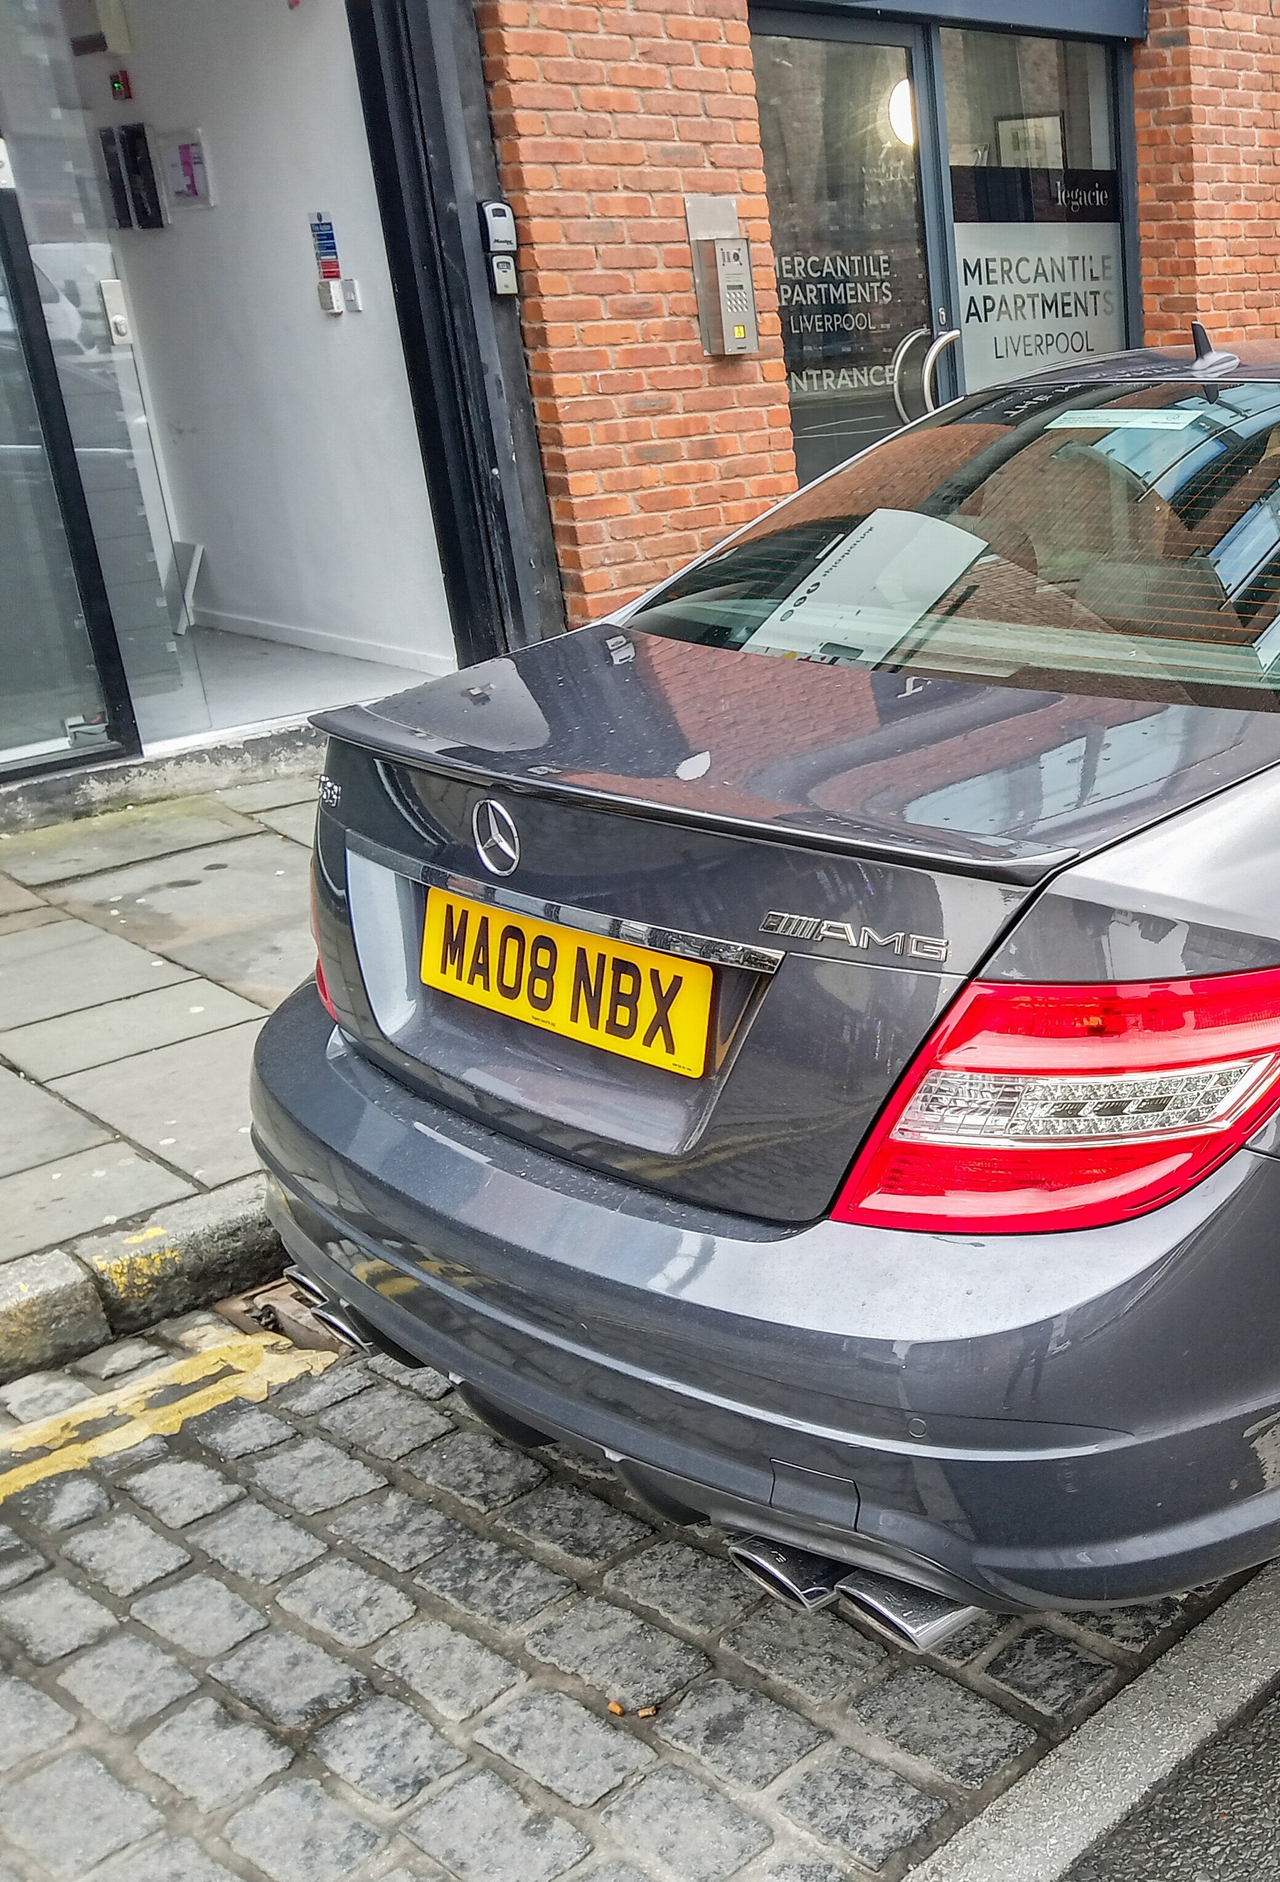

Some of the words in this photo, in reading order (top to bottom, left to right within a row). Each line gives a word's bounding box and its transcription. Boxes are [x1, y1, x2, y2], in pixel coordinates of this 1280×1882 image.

[1055, 181, 1109, 213] legacie
[962, 255, 1113, 286] MERCANTILE
[779, 282, 893, 306] PARTMENTS
[965, 290, 1115, 324] APARTMENTS
[790, 312, 876, 334] LIVERPOOL
[993, 330, 1095, 360] LIVERPOOL
[789, 364, 896, 393] NTRANCE
[812, 919, 949, 962] AMG
[440, 904, 558, 1012] MA08
[570, 946, 684, 1055] NBX
